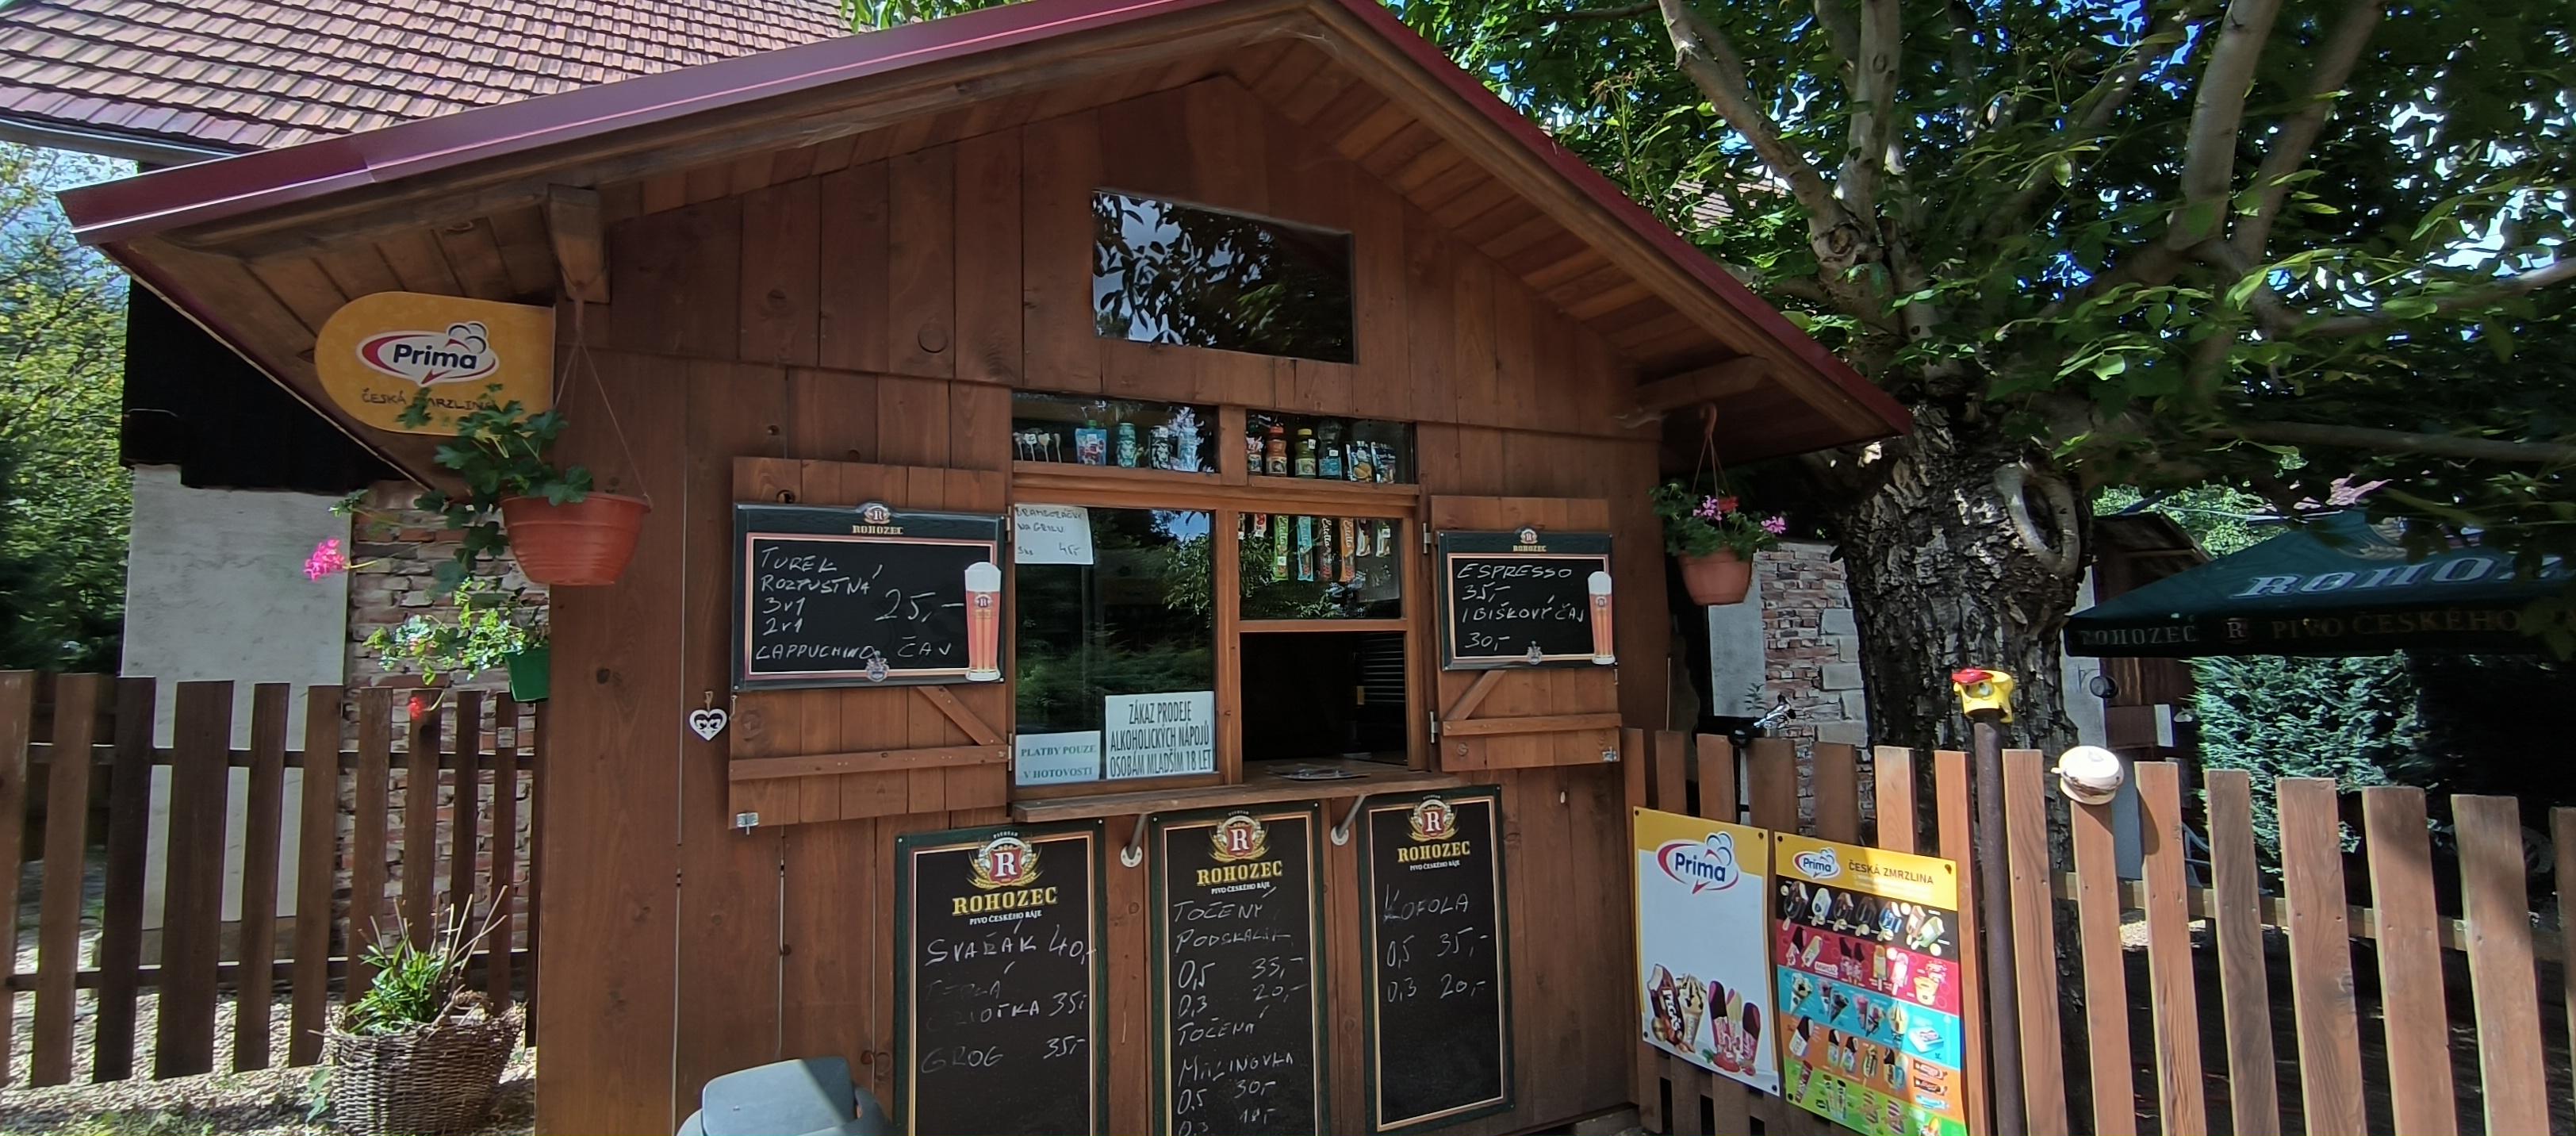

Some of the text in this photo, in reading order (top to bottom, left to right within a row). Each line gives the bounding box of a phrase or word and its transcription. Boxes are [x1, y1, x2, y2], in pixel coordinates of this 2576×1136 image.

[393, 343, 477, 370] Prima
[361, 387, 407, 405] ČESKÁ
[852, 524, 904, 535] ROHOZEC
[761, 546, 838, 574] TUREK
[1457, 562, 1573, 580] ESPRESSO
[1129, 699, 1192, 725] ZÁKAZ PRODEJE
[1110, 720, 1209, 752] ALKOHOLICKÝCH NÁPOJŮ
[1021, 744, 1097, 758] PLATBY POUZE
[1110, 748, 1213, 777] OSOBÁM MLADŠÍM 18 LET
[1023, 767, 1093, 779] V HOTOVOSTI
[1425, 811, 1442, 832] R
[1230, 828, 1250, 851] R
[1397, 841, 1471, 863] ROHOZEC
[994, 851, 1018, 877] R
[1195, 860, 1283, 887] ROHOZEC
[1674, 850, 1726, 883] Prima
[1802, 857, 1832, 873] Prima
[1848, 859, 1934, 885] ČESKÁ ZMRZLINA
[952, 885, 1059, 916] ROHOZEC
[1382, 883, 1470, 924] KOFOLA
[969, 909, 1043, 926] PIVO ČESKÉHO RÁJE
[921, 1046, 1004, 1074] GROG
